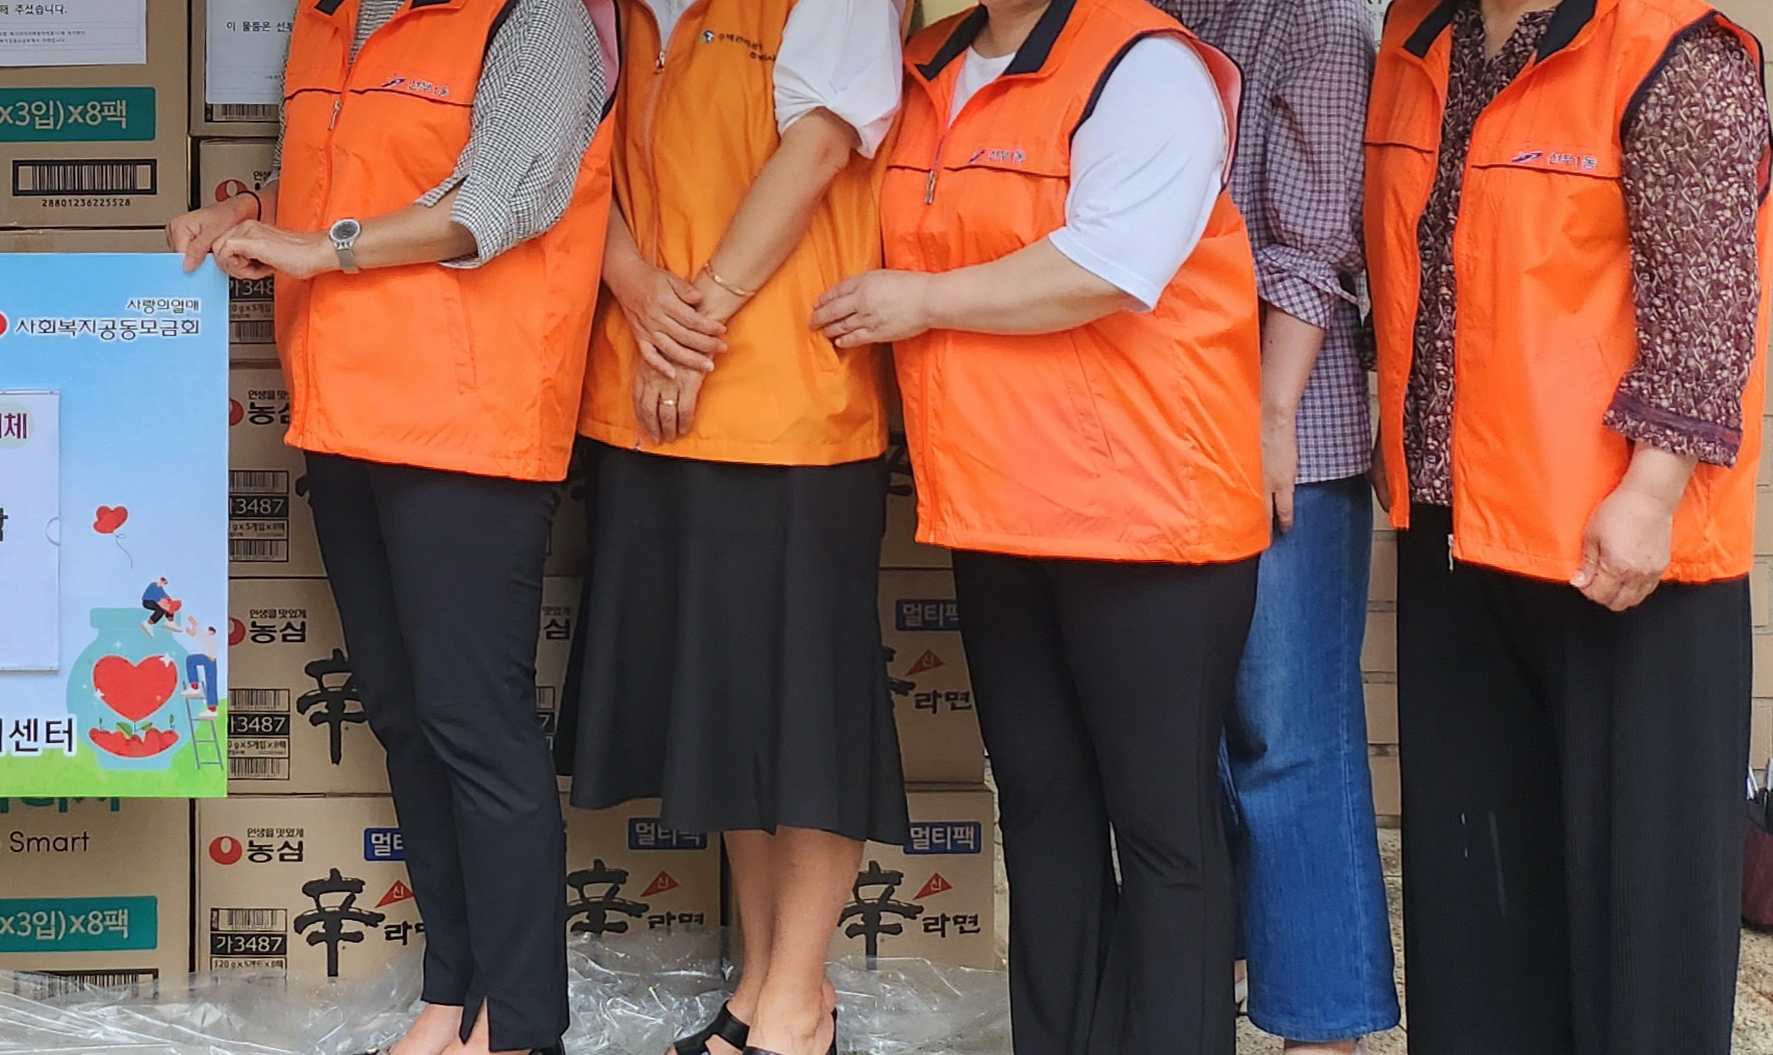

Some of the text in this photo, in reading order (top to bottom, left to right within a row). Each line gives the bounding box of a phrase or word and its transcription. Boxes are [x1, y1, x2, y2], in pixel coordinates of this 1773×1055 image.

[15, 3, 68, 15] 주셨습니다.
[227, 21, 236, 32] 이
[242, 21, 271, 32] 물품은
[127, 299, 199, 314] 사랑의열매
[15, 318, 199, 340] 사회복지공동모금회
[249, 621, 306, 643] 농심
[914, 689, 973, 714] 라면
[10, 831, 90, 853] Smart
[911, 825, 974, 852] 멀티팩
[247, 840, 303, 863] 농심
[393, 887, 404, 898] 신
[930, 877, 942, 891] 신
[293, 867, 386, 977] 辛
[837, 860, 923, 970] 辛
[923, 912, 980, 937] 라면
[384, 921, 425, 946] 라
[216, 936, 283, 954] 가3487
